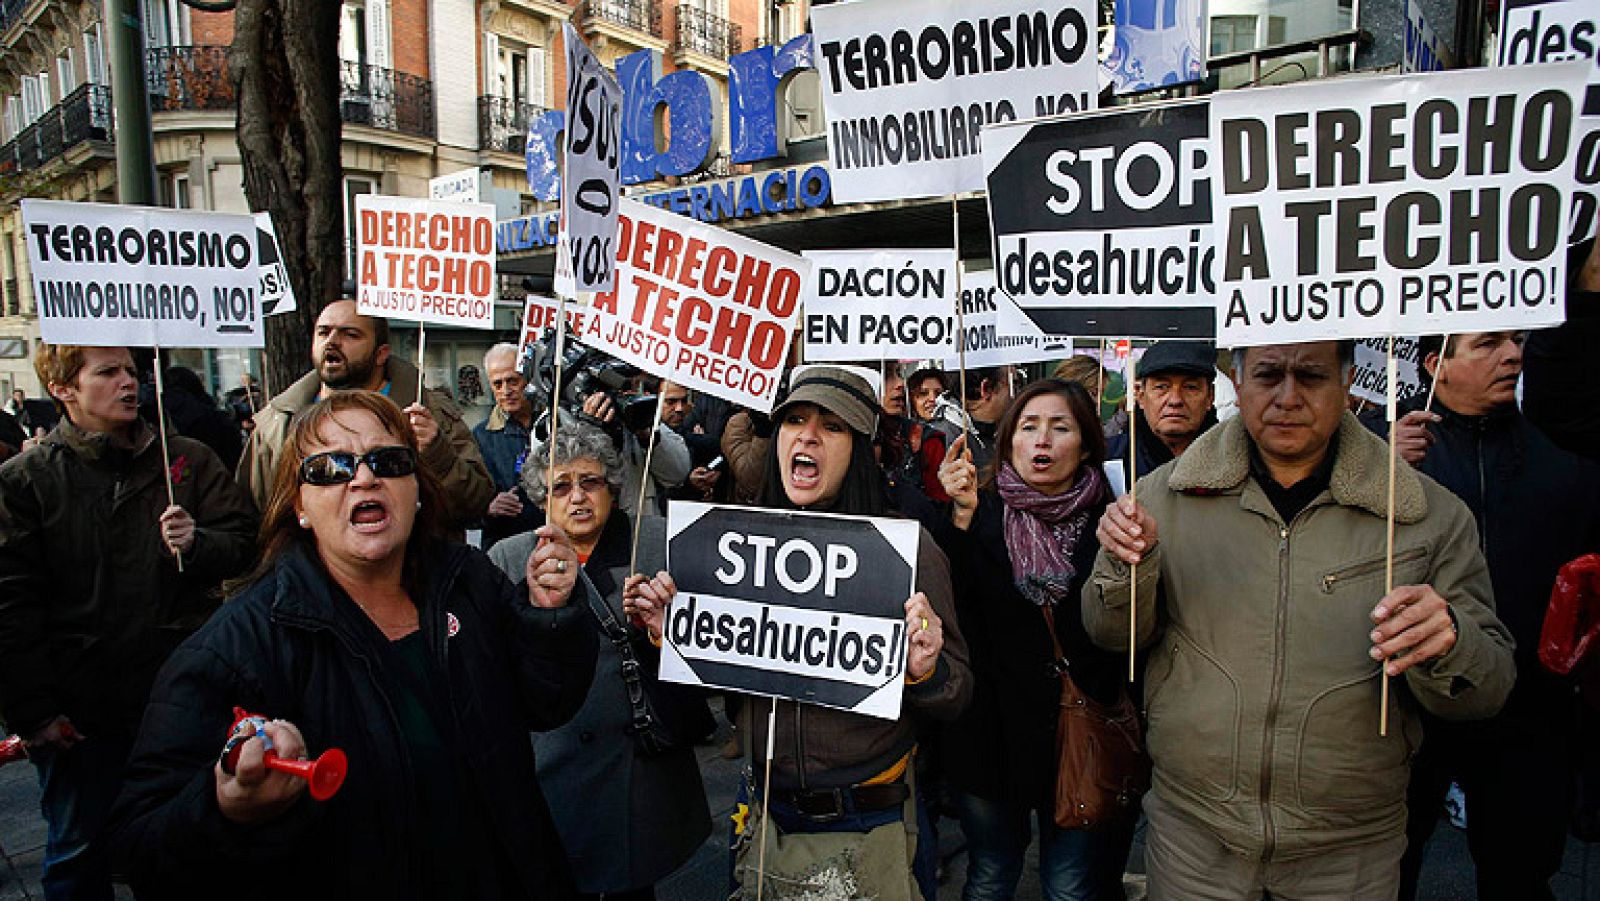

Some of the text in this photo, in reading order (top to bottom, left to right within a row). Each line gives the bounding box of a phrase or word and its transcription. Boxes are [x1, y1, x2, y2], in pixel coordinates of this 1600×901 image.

[820, 7, 1087, 94] TERRORISMO
[1222, 89, 1573, 195] DERECHO
[1045, 138, 1211, 215] STOP
[30, 224, 251, 269] TERRORISMO
[361, 209, 492, 255] DERECHO
[1224, 205, 1270, 282] A
[1285, 183, 1562, 276] TECHO
[361, 250, 492, 297] A TECHO
[616, 214, 801, 318] DERECHO
[818, 260, 945, 299] DACIÓN
[1225, 267, 1557, 327] A JUSTO PRECIO!
[39, 280, 255, 327] INMOBILIARIO, NO!
[361, 289, 490, 320] A JUSTO PRECIO!
[631, 275, 786, 370] TECHO
[807, 314, 953, 345] EN PAGO!
[587, 315, 774, 400] A JUSTO PRECIO!
[715, 531, 858, 597] STOP
[673, 596, 900, 677] desahucios!
